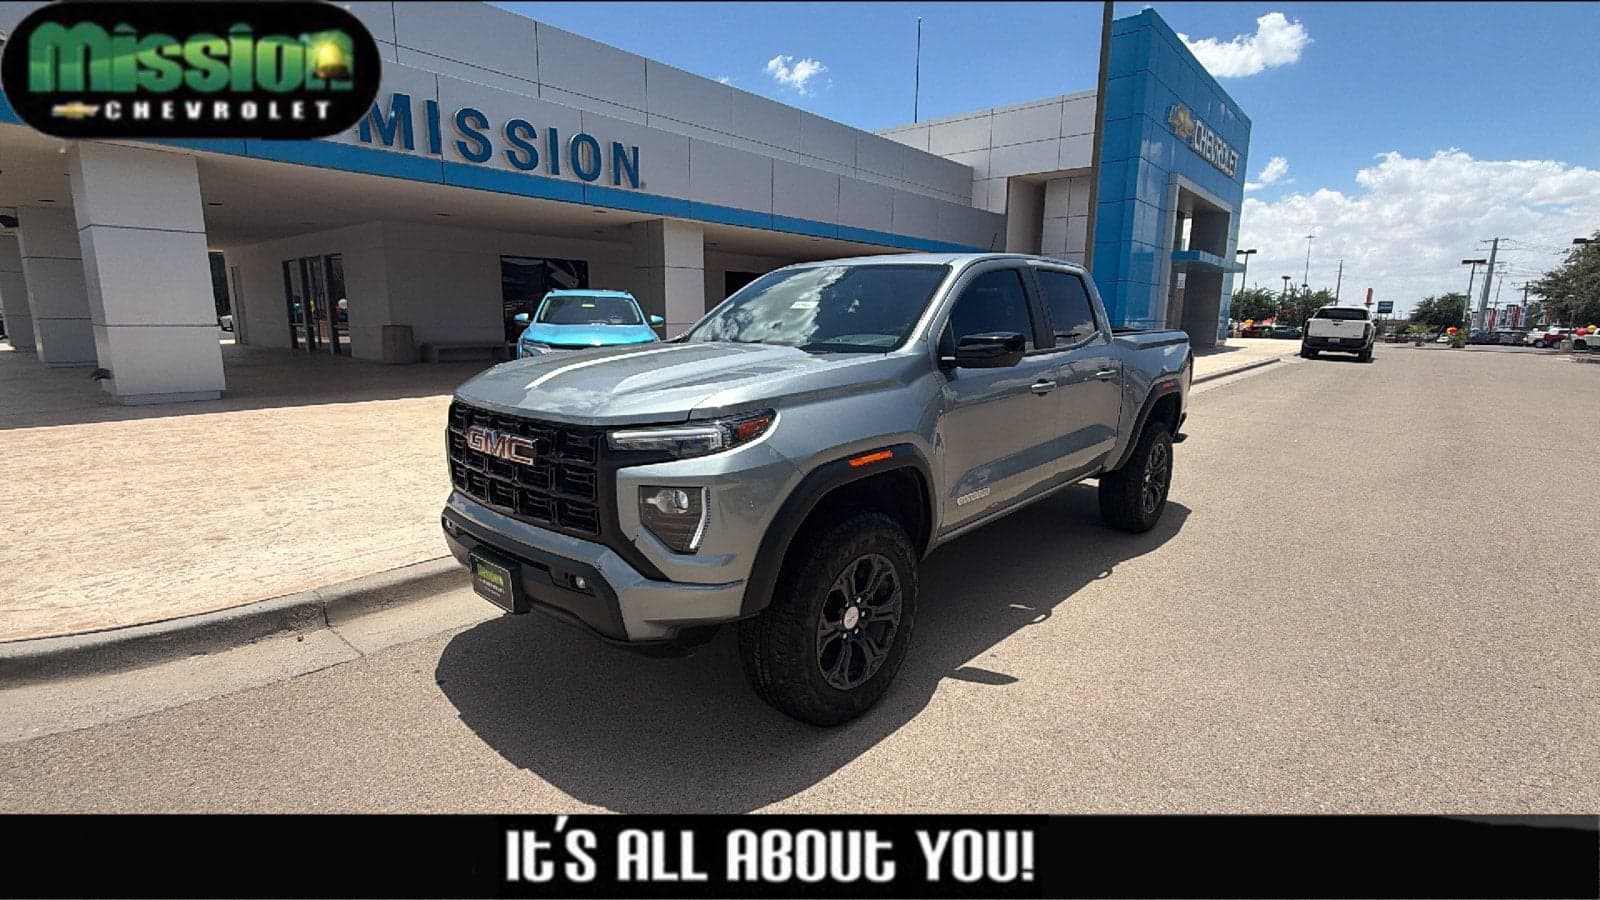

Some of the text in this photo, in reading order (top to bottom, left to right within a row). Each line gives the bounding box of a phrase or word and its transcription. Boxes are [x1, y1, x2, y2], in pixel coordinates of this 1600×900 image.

[358, 93, 640, 189] MISSION
[1194, 120, 1239, 177] CHEVROLET
[467, 425, 536, 466] GMC
